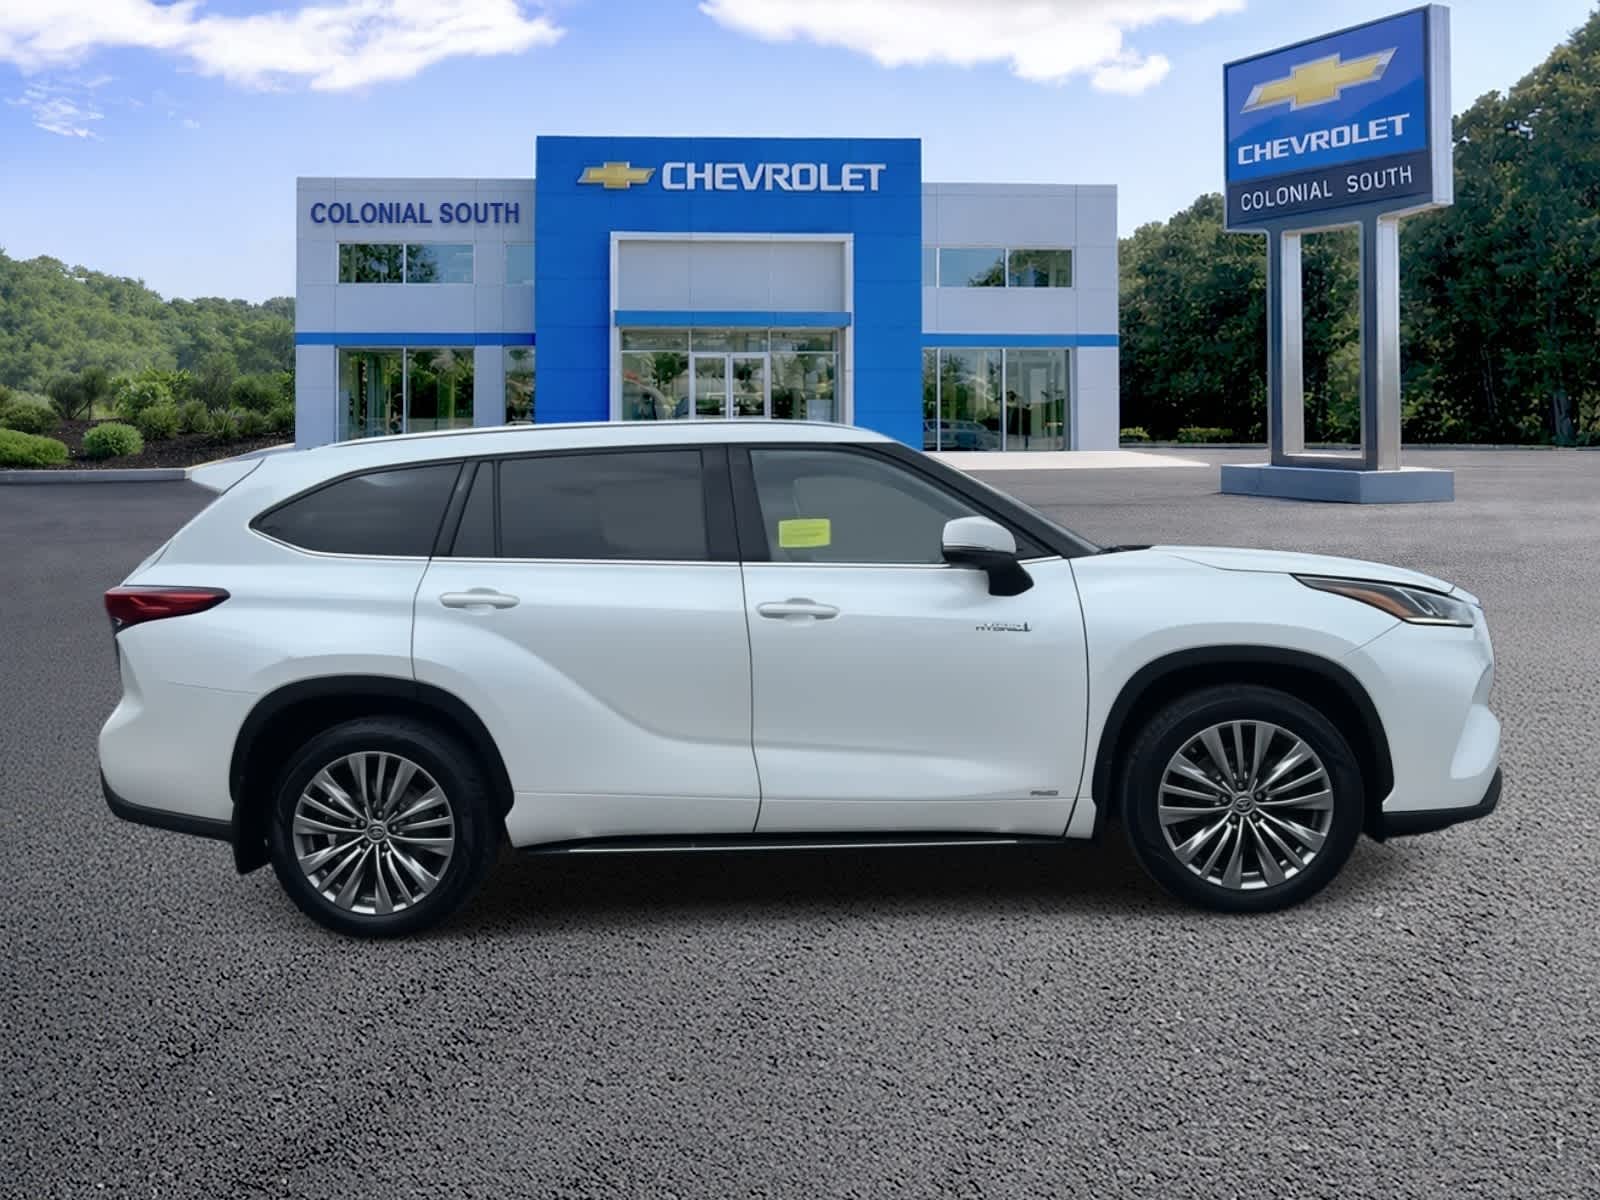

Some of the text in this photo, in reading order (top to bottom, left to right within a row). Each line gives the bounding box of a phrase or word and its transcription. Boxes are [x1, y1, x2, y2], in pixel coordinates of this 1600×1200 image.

[1237, 113, 1410, 165] CHEVROLET
[662, 162, 887, 191] CHEVROLET
[1240, 165, 1413, 211] COLONIAL SOUTH
[310, 202, 520, 224] COLONIAL SOUTH
